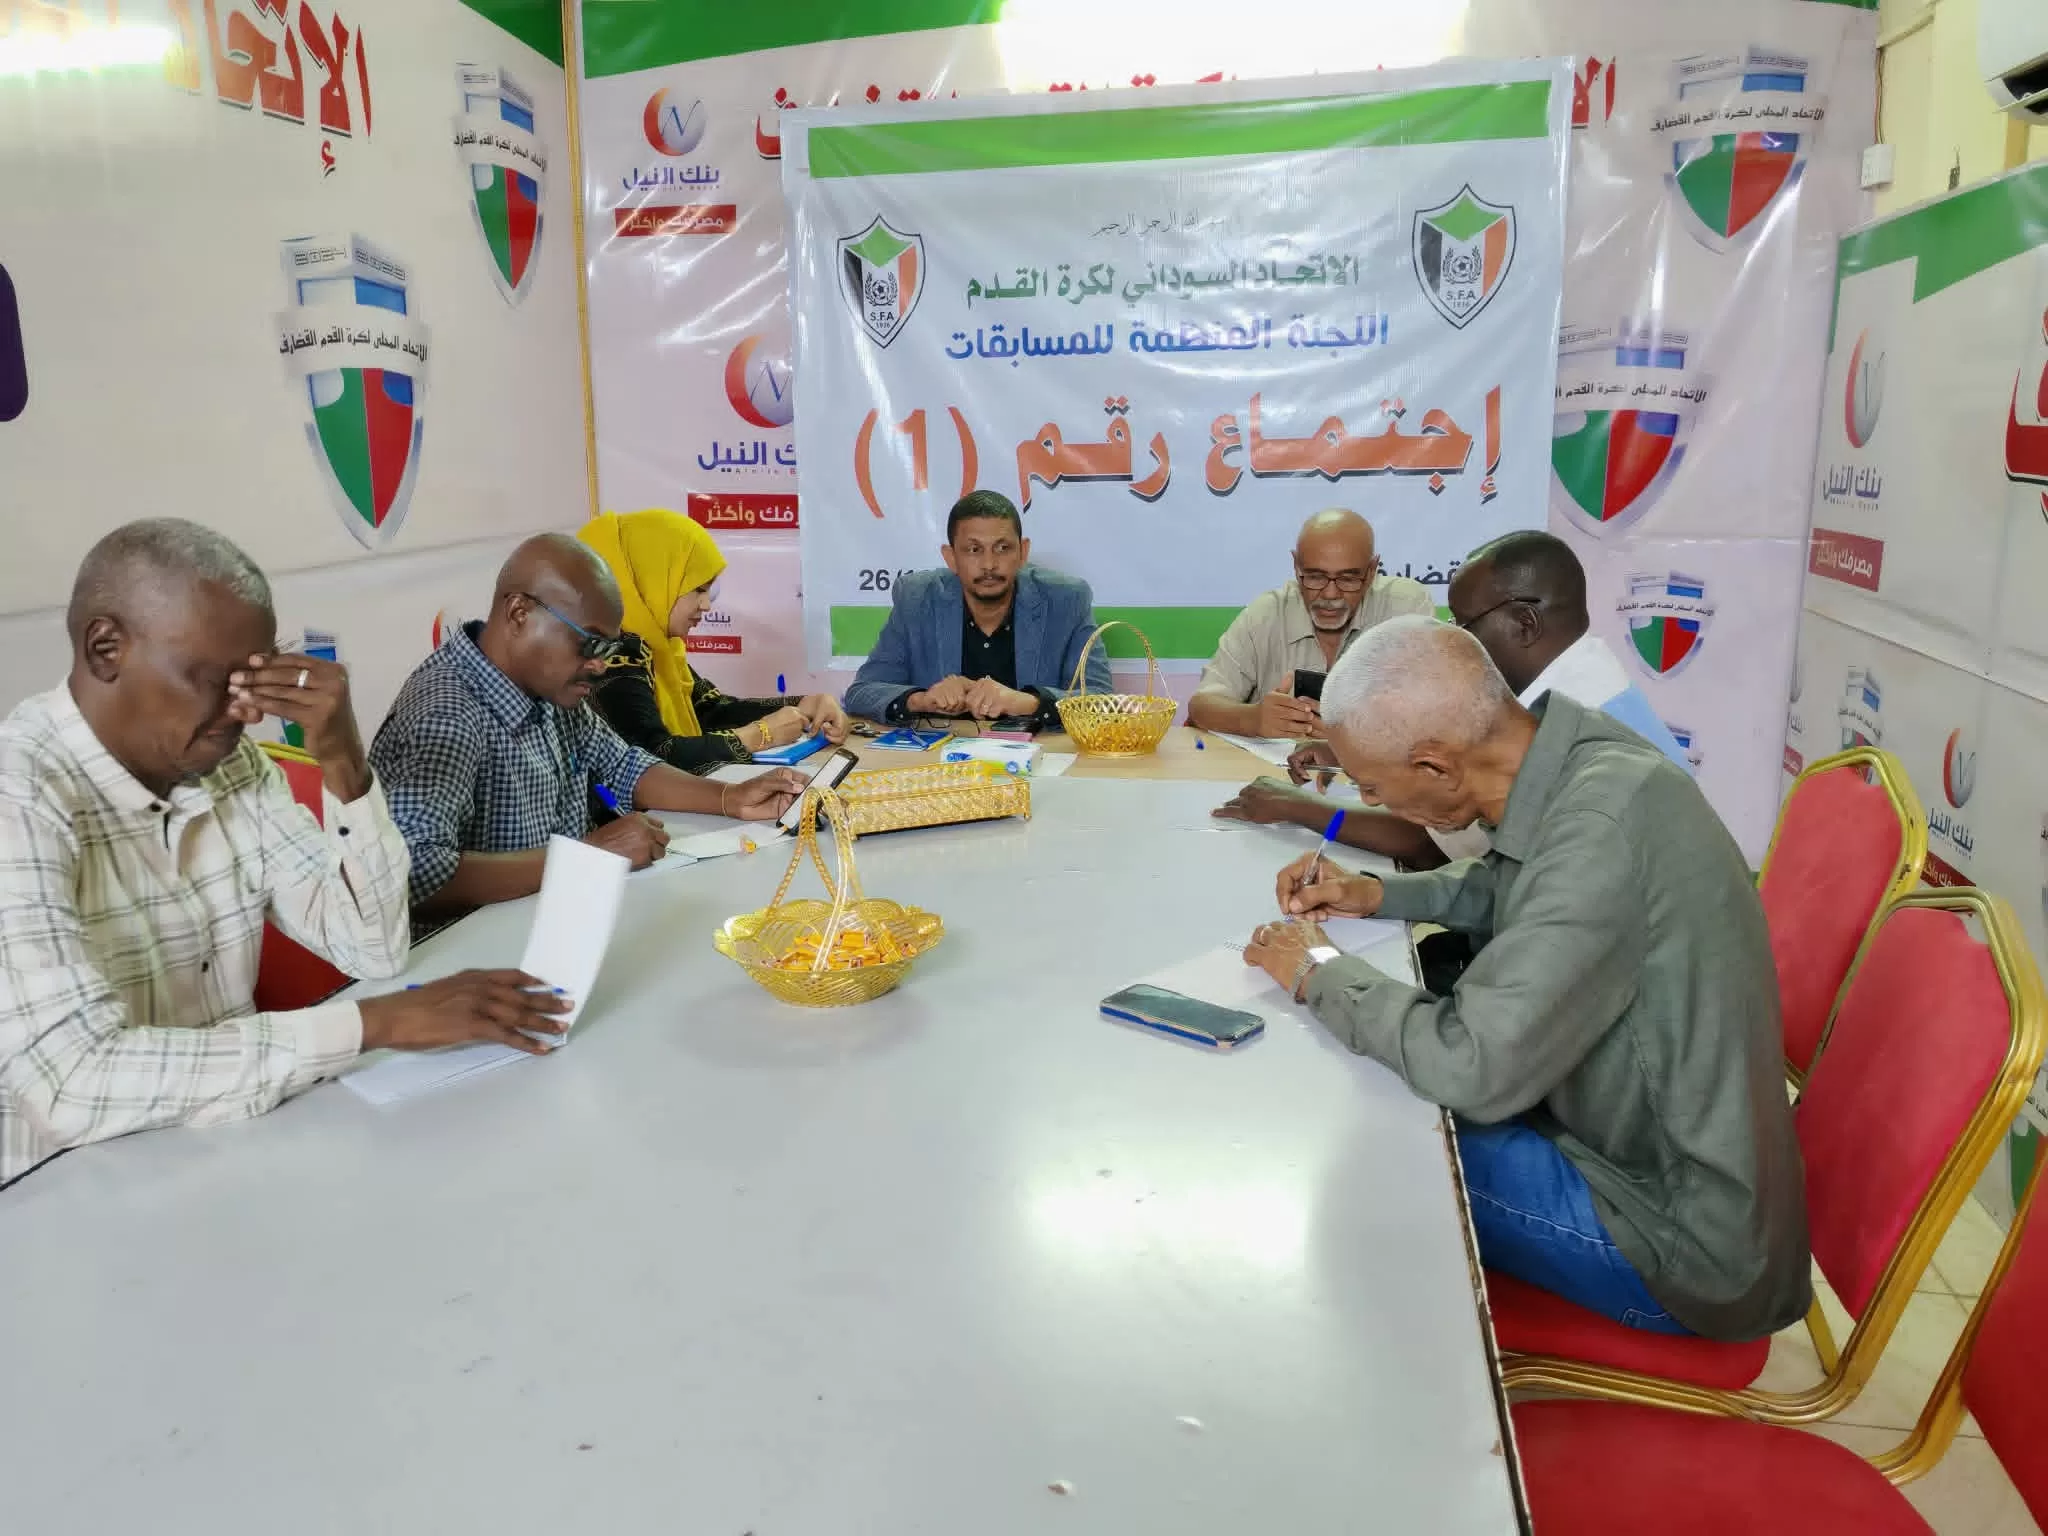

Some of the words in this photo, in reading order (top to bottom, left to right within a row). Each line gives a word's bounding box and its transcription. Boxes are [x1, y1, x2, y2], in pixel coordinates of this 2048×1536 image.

[622, 166, 674, 192] النيل
[679, 164, 720, 184] بنك
[966, 268, 1049, 310] القدم
[1057, 263, 1116, 304] لكرة
[320, 325, 344, 347] القدم
[944, 322, 1115, 369] للمسابقات
[1128, 318, 1273, 352] المنظمة
[1286, 312, 1390, 358] اللجنة
[697, 440, 767, 472] النيل
[853, 403, 979, 519] (1)
[1015, 395, 1171, 514] رقم
[1205, 383, 1501, 505] إجتماع
[706, 499, 755, 525] وأكثر
